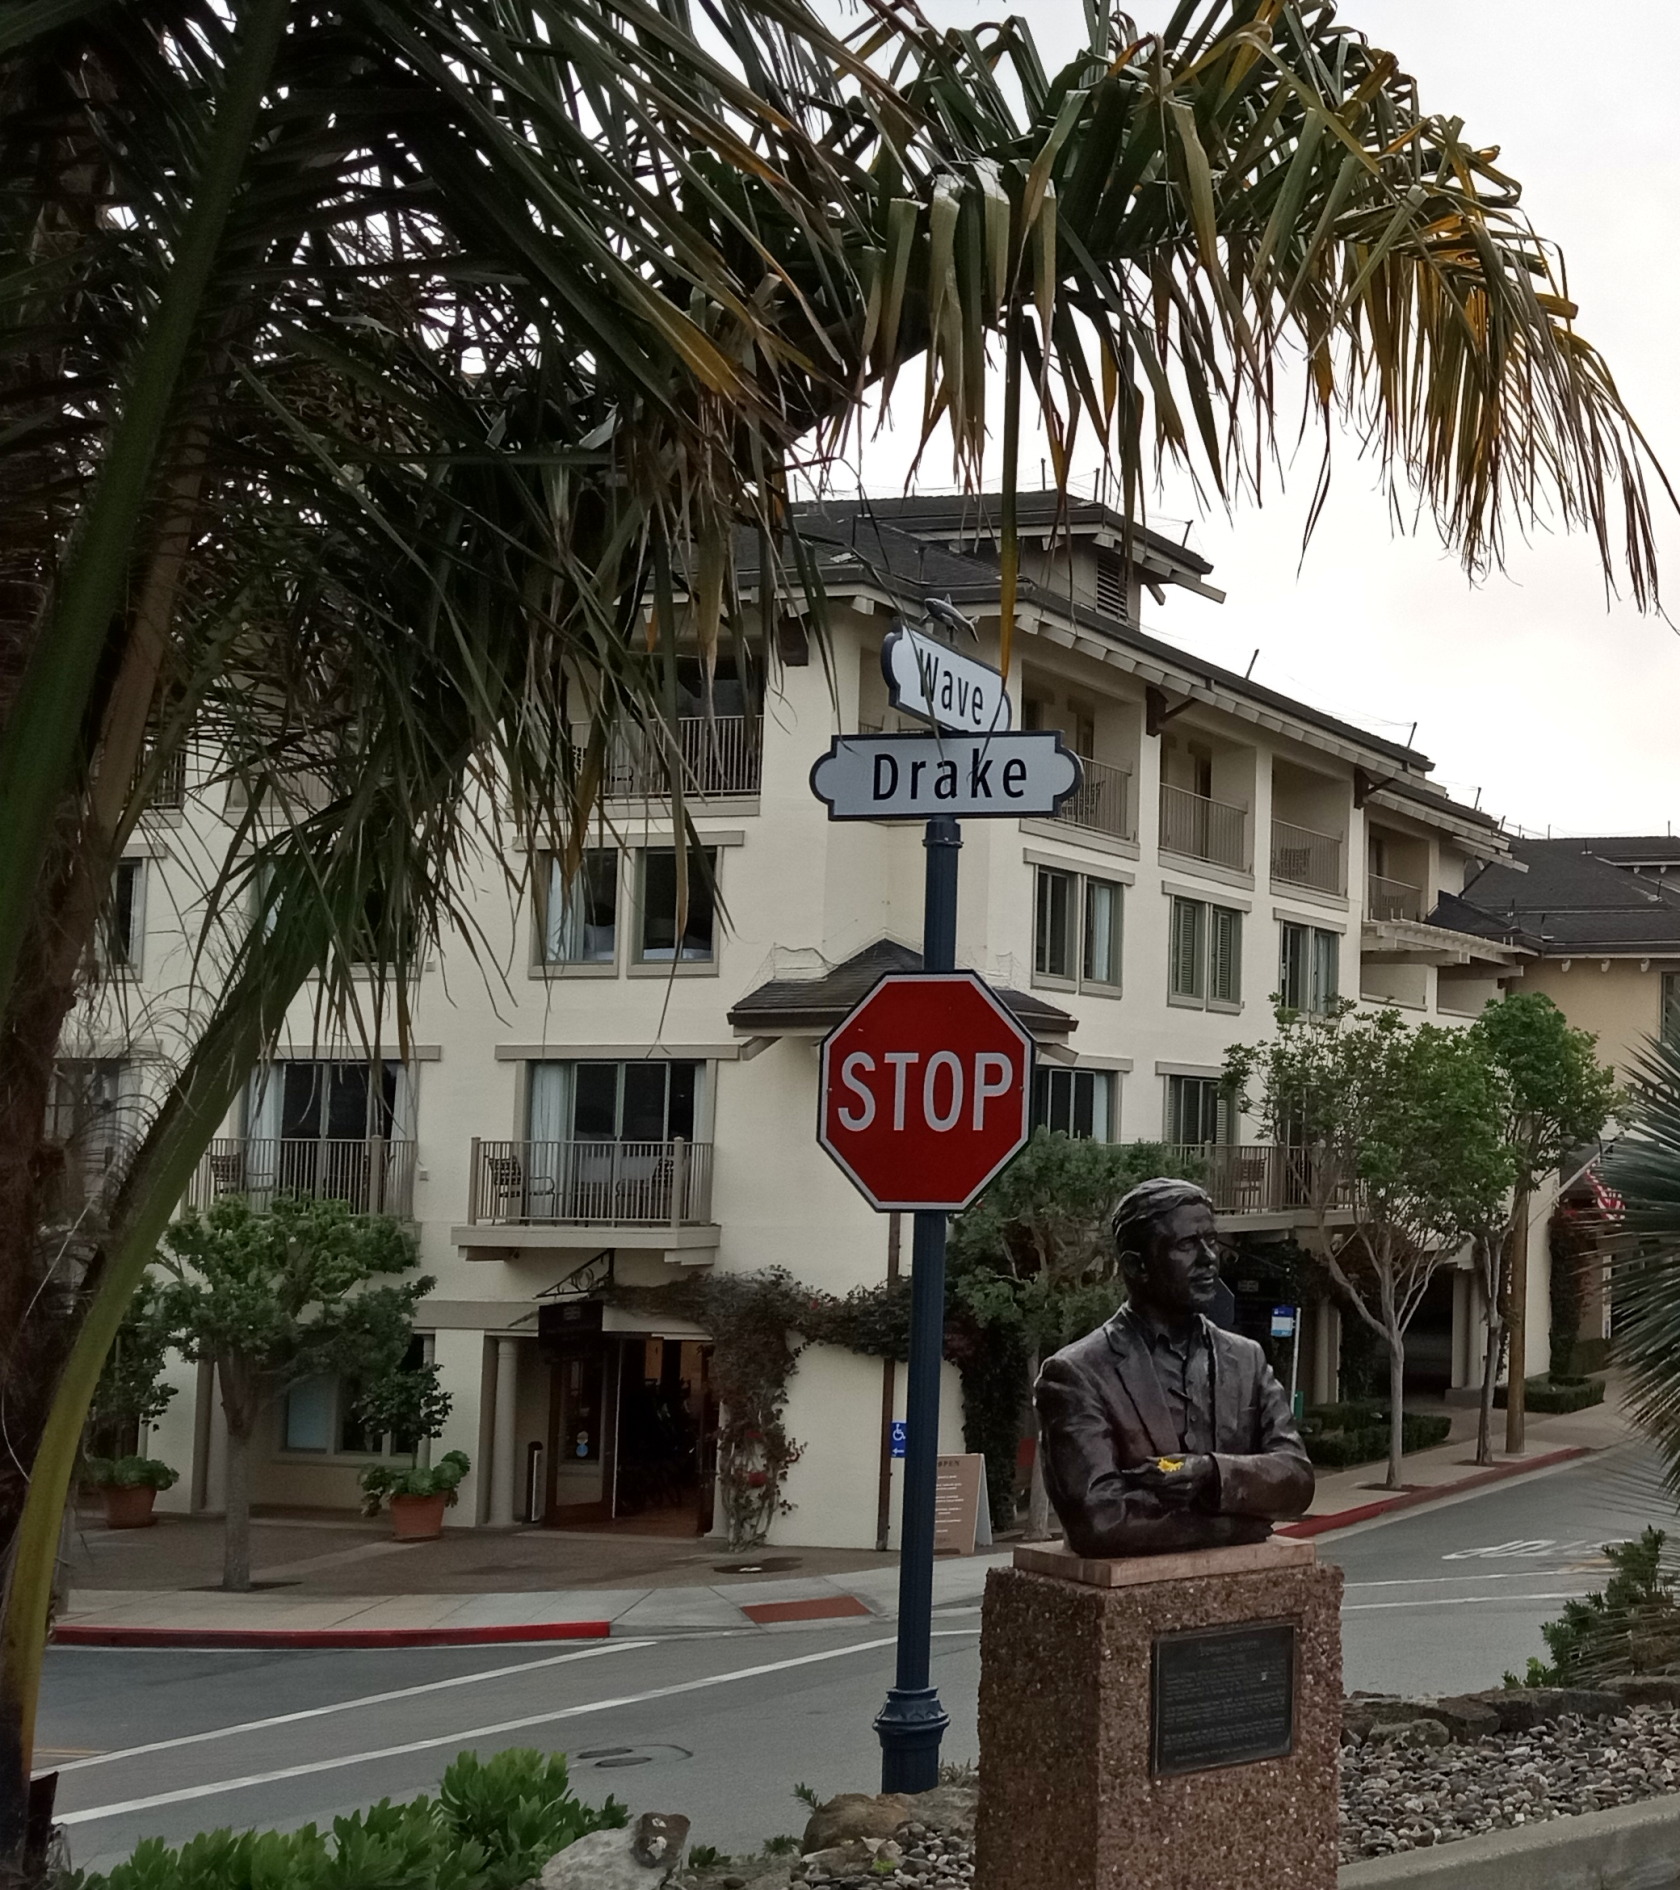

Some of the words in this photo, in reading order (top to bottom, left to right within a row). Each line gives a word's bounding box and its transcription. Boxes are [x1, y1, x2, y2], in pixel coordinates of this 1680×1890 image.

[919, 647, 983, 726] Wave
[873, 748, 1027, 801] Drake
[838, 1051, 1013, 1132] STOP
